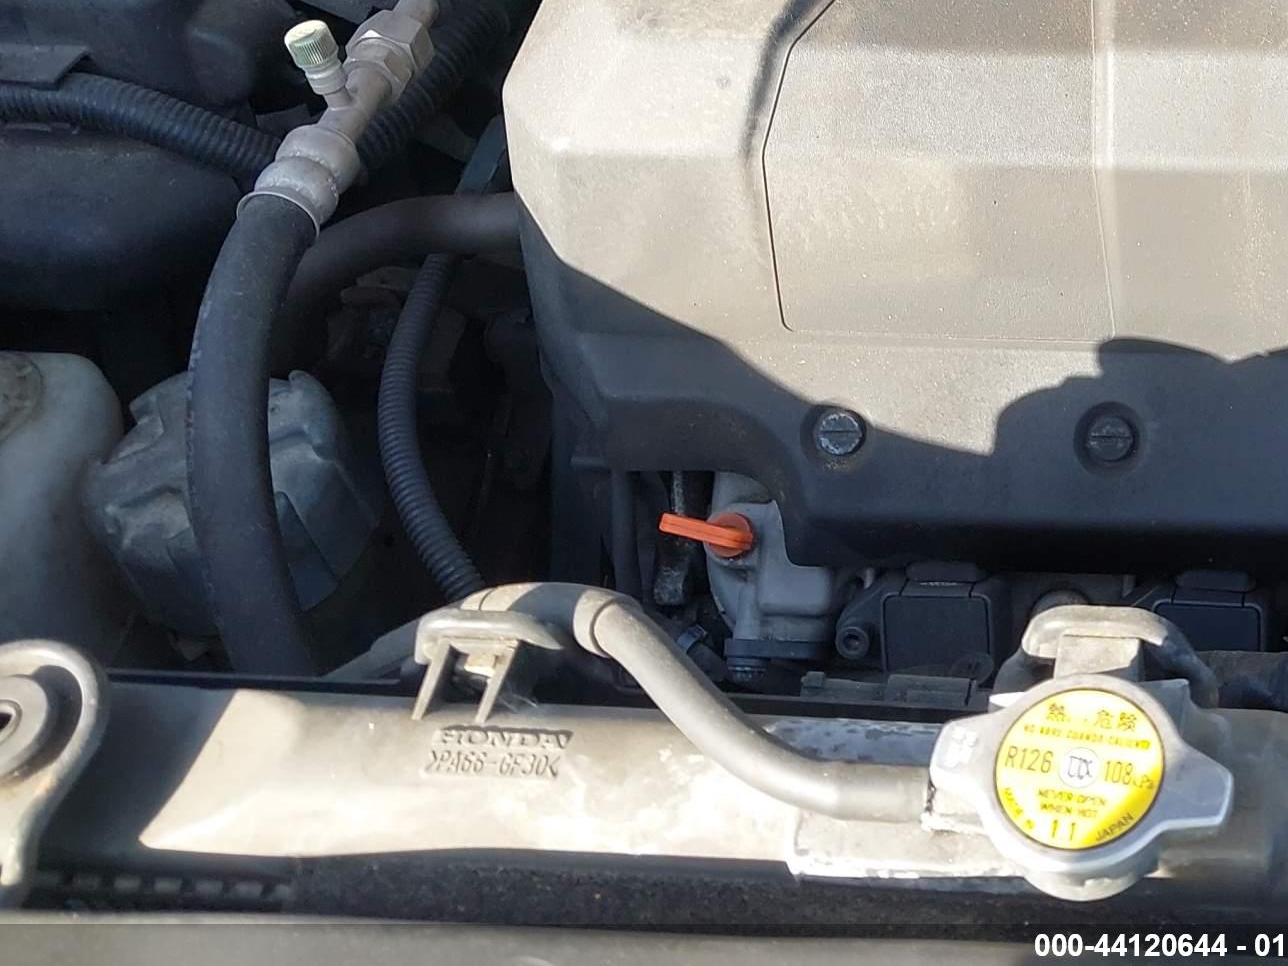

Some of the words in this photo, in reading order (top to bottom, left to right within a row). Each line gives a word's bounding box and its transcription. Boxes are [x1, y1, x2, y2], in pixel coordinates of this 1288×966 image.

[440, 725, 574, 749] HONDA
[1004, 745, 1054, 774] R126
[1095, 811, 1136, 842] JAPAN
